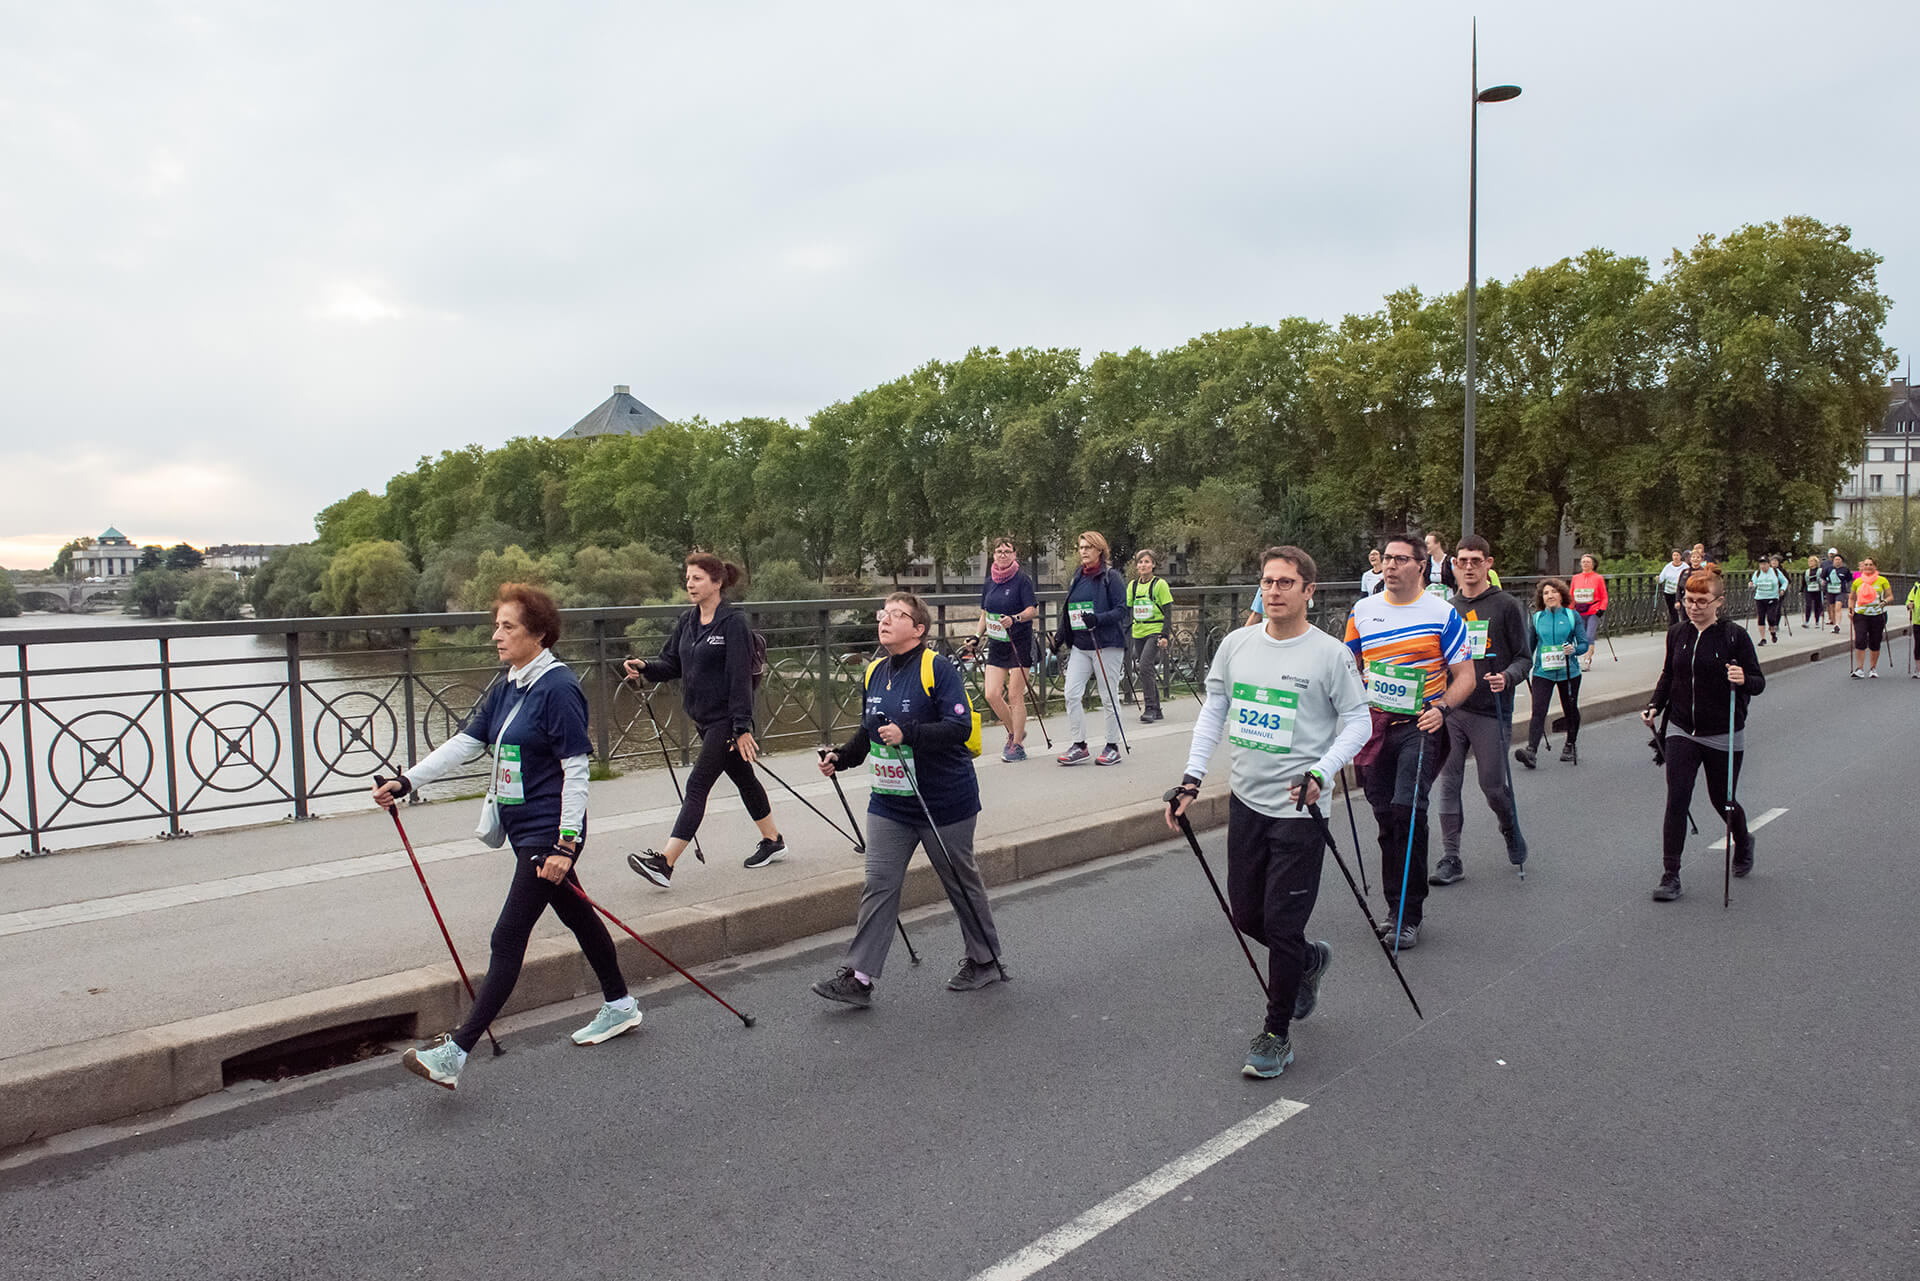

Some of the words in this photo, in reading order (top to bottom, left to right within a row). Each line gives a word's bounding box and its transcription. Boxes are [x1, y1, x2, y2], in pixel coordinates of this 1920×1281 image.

[1374, 680, 1407, 697] 5099
[1239, 708, 1281, 730] 5243
[1240, 727, 1274, 740] EMMANUEL
[875, 763, 905, 779] 5156
